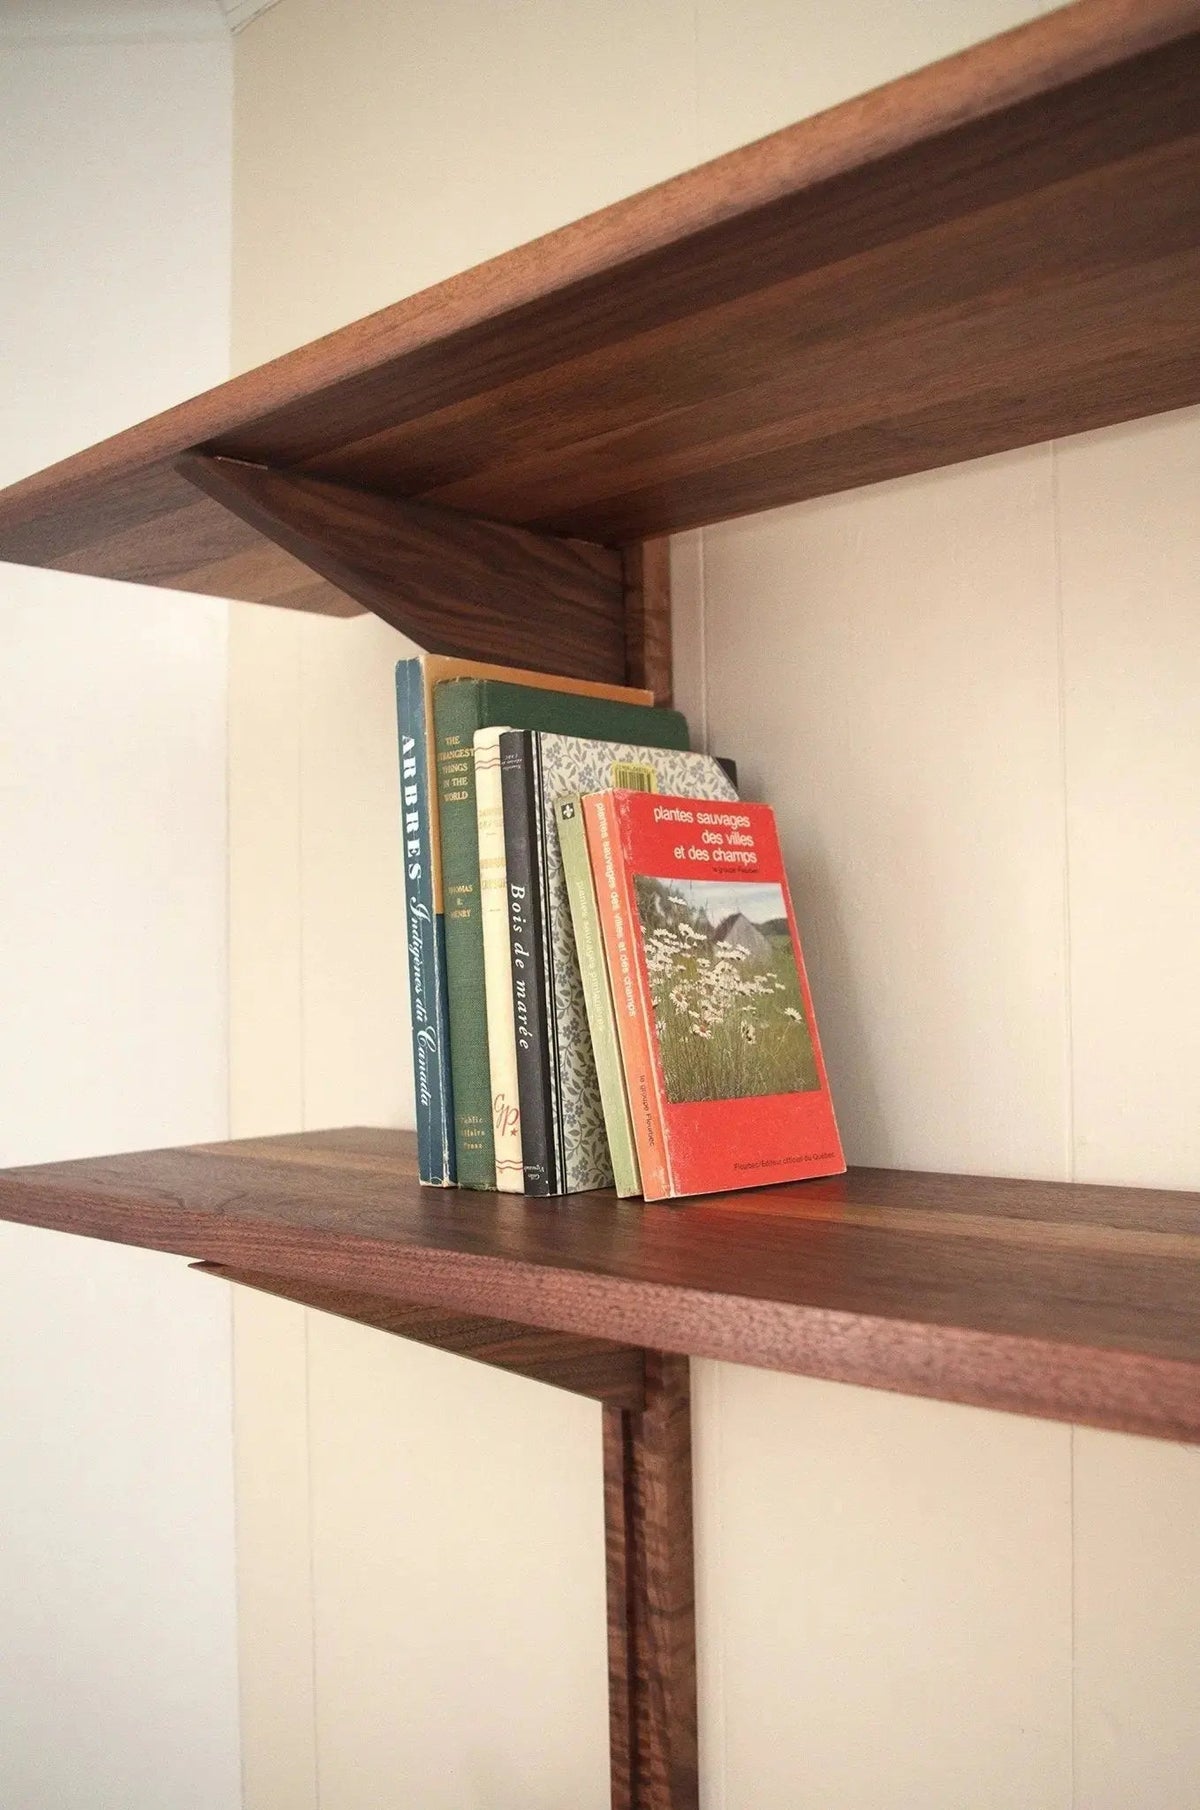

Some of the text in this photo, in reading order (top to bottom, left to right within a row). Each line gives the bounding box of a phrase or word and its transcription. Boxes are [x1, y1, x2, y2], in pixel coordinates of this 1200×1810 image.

[444, 735, 460, 746] THE
[451, 776, 469, 786] THE
[653, 806, 751, 830] plantes sauvages
[701, 829, 755, 847] des villes
[673, 845, 758, 867] et des champs
[402, 735, 437, 1107] ARBRES Indigènes du Canada
[595, 803, 637, 1018] plantes sauvages des villes et des champs
[511, 884, 534, 1050] Bois de marée
